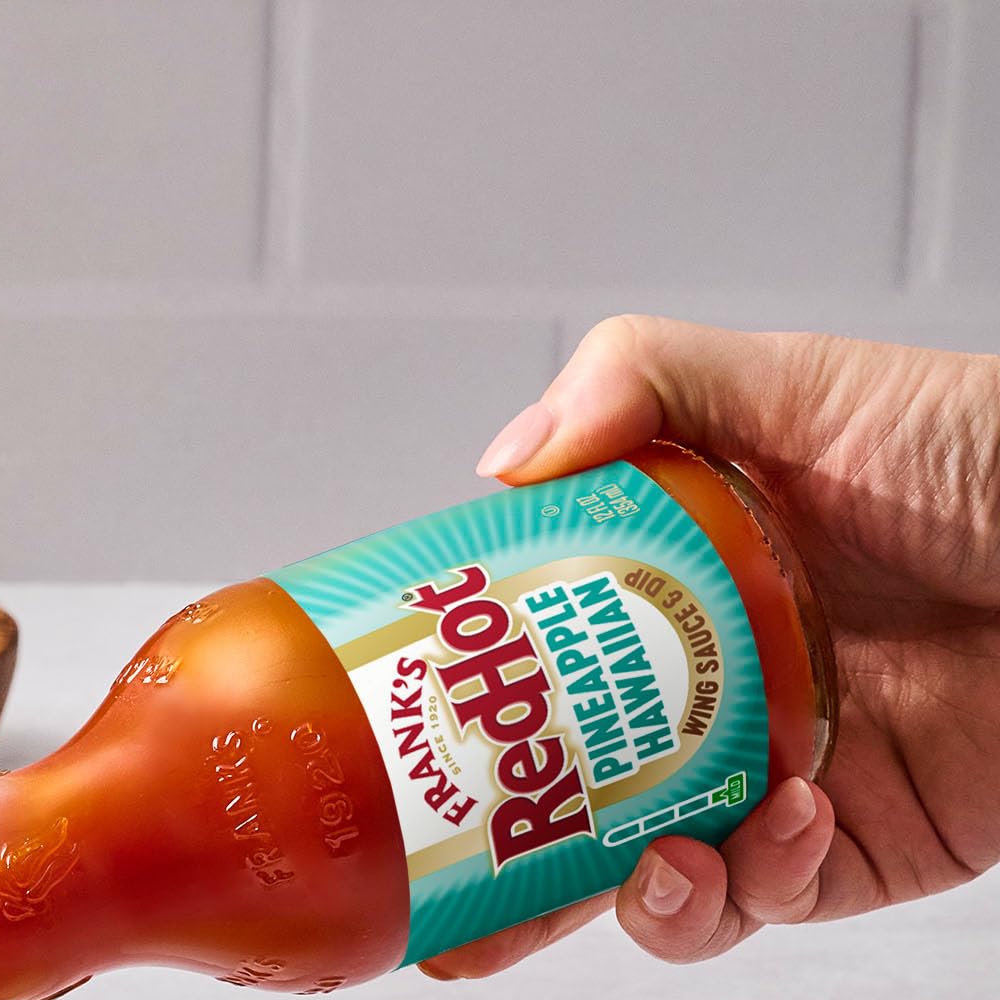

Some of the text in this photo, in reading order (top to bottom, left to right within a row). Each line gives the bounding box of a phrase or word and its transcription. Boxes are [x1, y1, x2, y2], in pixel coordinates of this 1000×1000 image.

[592, 509, 616, 524] 12
[609, 496, 641, 518] (354
[405, 564, 595, 868] RedHot
[525, 584, 634, 784] PINEAPPLE
[571, 575, 675, 762] HAWAIIAN
[624, 567, 720, 737] WING SAUCE & DIP
[290, 722, 360, 859] 1920
[391, 656, 480, 828] FRANK'S
[428, 695, 462, 776] SINCE 1920
[730, 779, 741, 801] MILD
